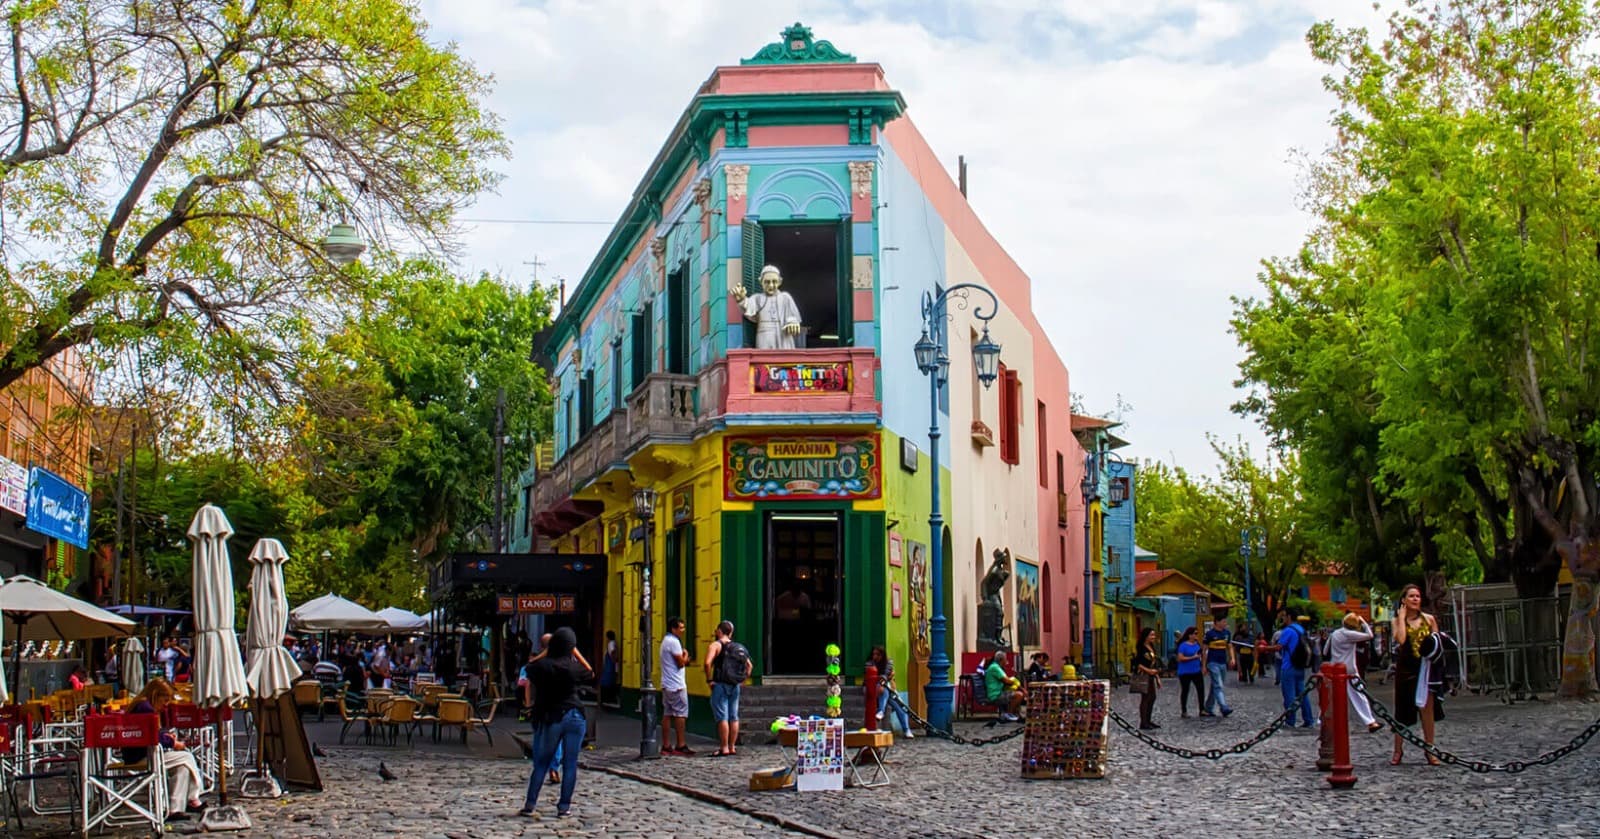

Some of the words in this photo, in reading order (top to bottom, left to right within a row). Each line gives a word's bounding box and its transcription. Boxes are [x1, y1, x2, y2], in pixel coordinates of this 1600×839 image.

[774, 443, 831, 455] HAVANNA
[749, 456, 857, 479] CAMINITO
[522, 599, 553, 609] TANGO
[121, 730, 142, 739] COFFEE
